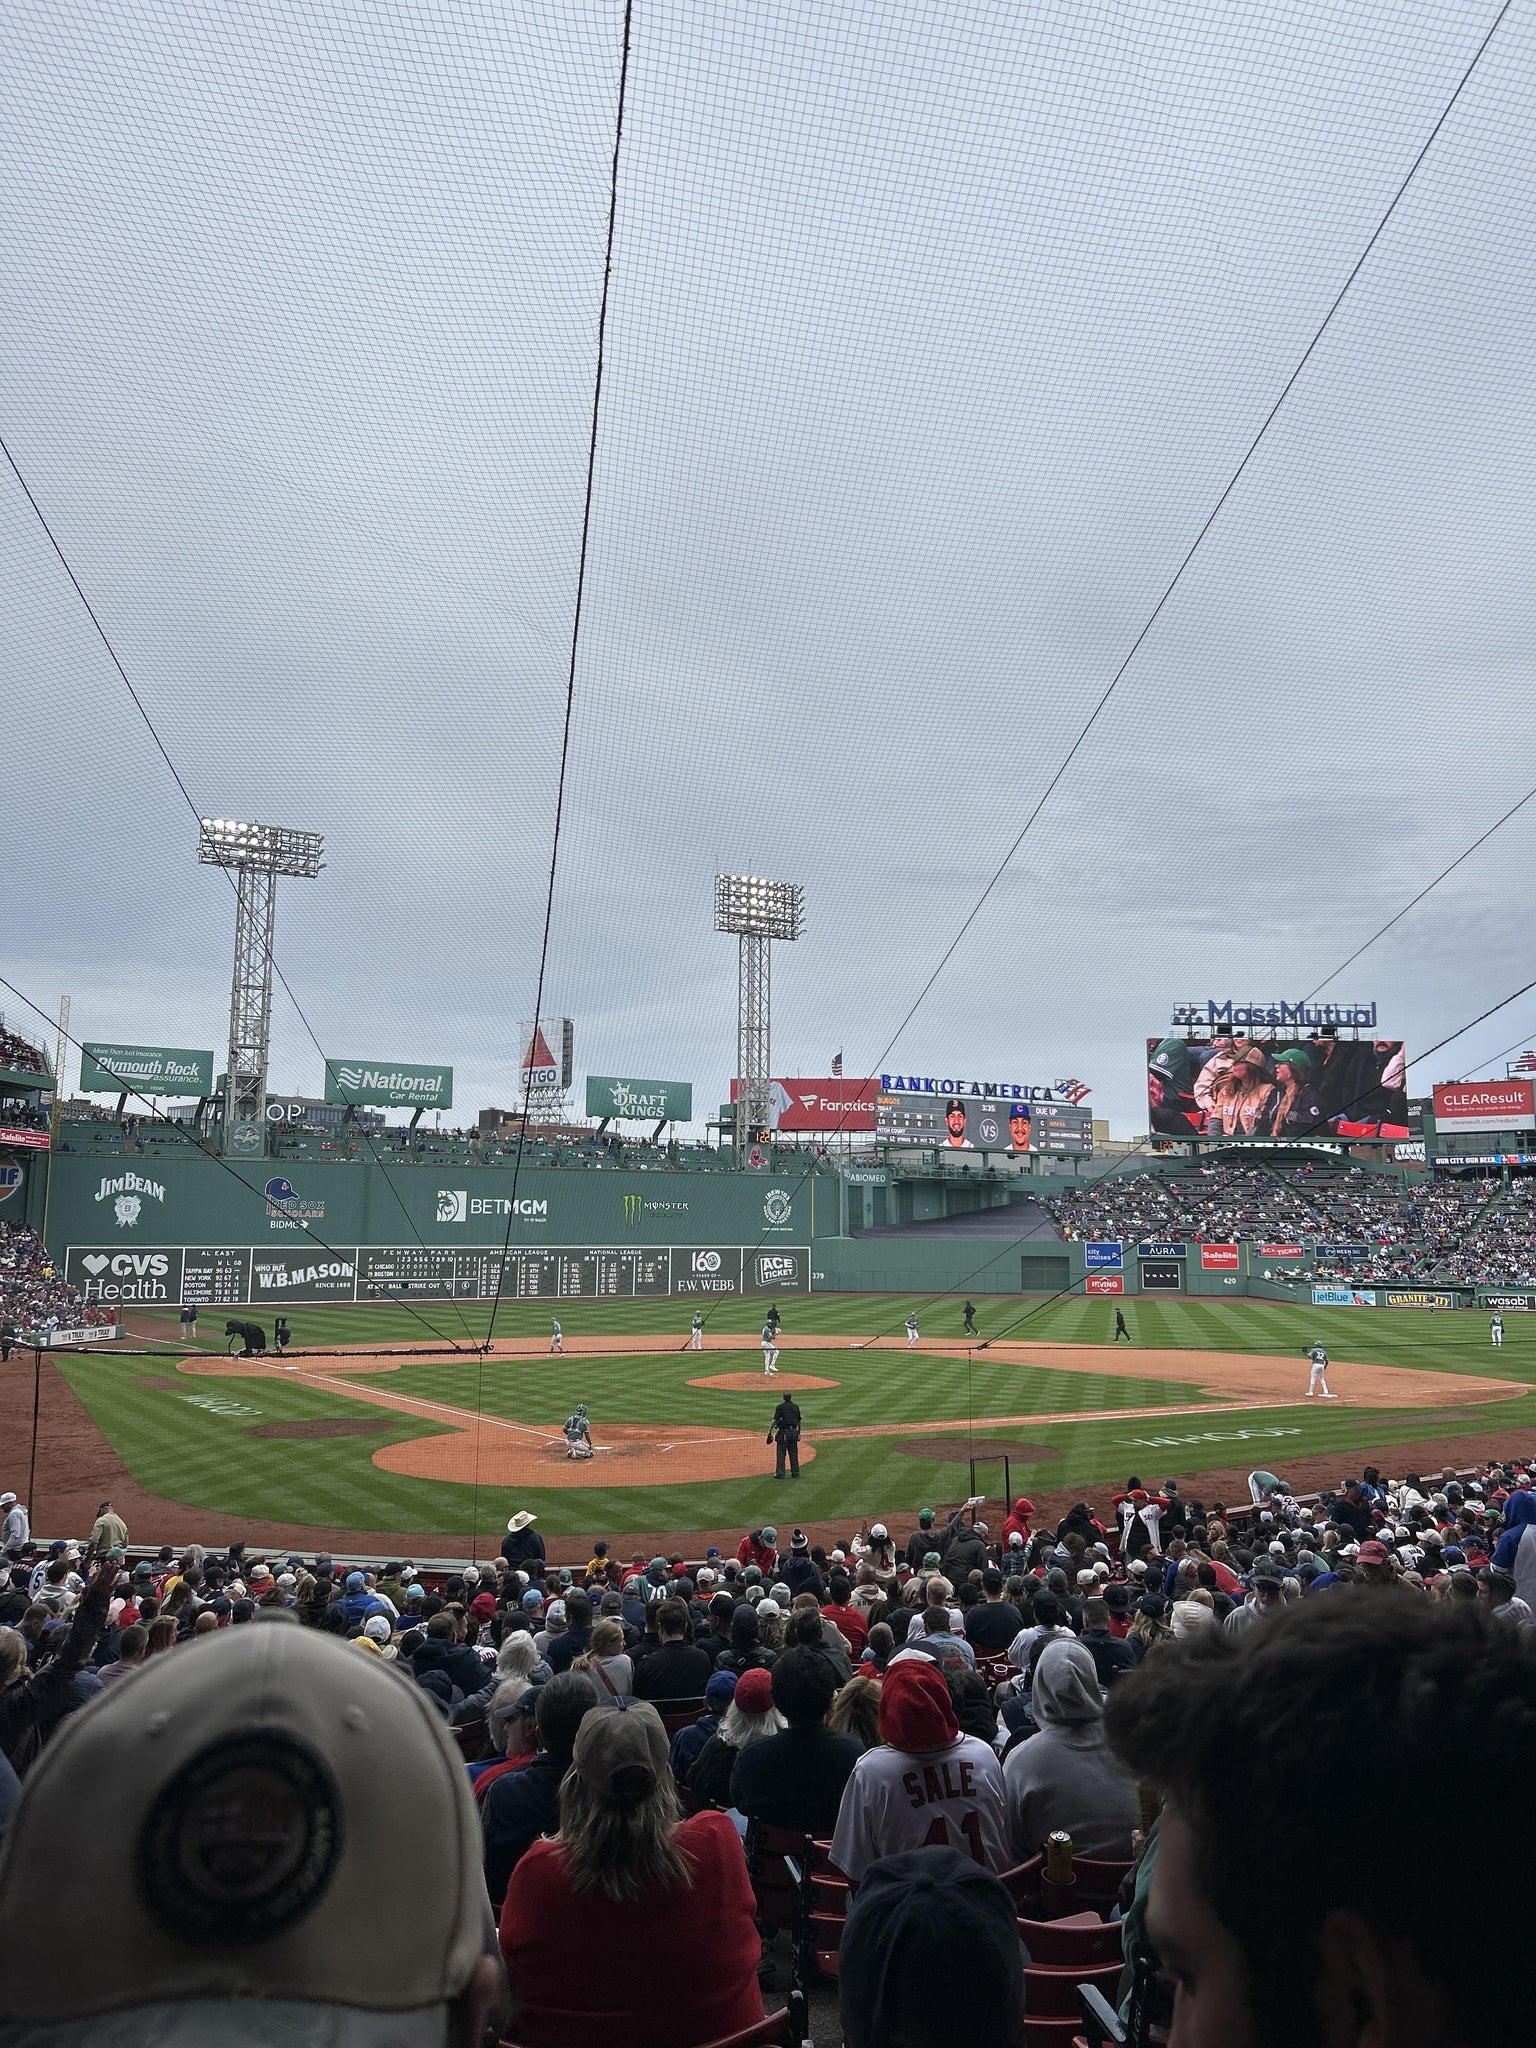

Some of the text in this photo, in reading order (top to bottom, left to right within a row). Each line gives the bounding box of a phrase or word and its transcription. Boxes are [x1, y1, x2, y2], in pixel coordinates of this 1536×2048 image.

[1208, 1000, 1376, 1026] MassMutual
[96, 1057, 200, 1076] Plymouth Rock
[522, 1070, 557, 1084] CTGO
[881, 1075, 1053, 1101] BANK OF AMERICA
[390, 1091, 438, 1101] Car Rental
[613, 1093, 667, 1106] DRAFT
[877, 1097, 900, 1105] BURGOS
[1444, 1092, 1524, 1106] CLEAResult
[619, 1104, 665, 1117] KINGS
[820, 1099, 875, 1112] Fanatics
[981, 1104, 995, 1112] 3:35
[1049, 1108, 1058, 1116] UP
[1451, 1118, 1519, 1126] clearesult.com/redsox
[1, 1132, 26, 1143] Safelite
[983, 1126, 996, 1138] VS
[850, 1174, 886, 1182] ABIOMED
[271, 1201, 325, 1210] RED SOX
[470, 1199, 548, 1215] BETMGM
[643, 1201, 689, 1211] MONSTER
[270, 1221, 299, 1229] BIDMC
[1203, 1251, 1238, 1259] Safelite
[1277, 1247, 1303, 1256] TICKET
[111, 1254, 169, 1276] CVS
[691, 1251, 721, 1272] 160
[764, 1258, 793, 1271] ACE
[272, 1264, 286, 1272] BUT
[764, 1268, 793, 1280] TICKET
[83, 1278, 168, 1300] Health
[677, 1279, 735, 1292] F.W. WEBB
[1317, 1291, 1348, 1303] jetBlue
[1388, 1294, 1428, 1305] GRANITE
[1488, 1296, 1528, 1306] wasabi
[1316, 1351, 1325, 1360] 32
[647, 1583, 667, 1600] 70
[902, 1761, 977, 1809] SALE
